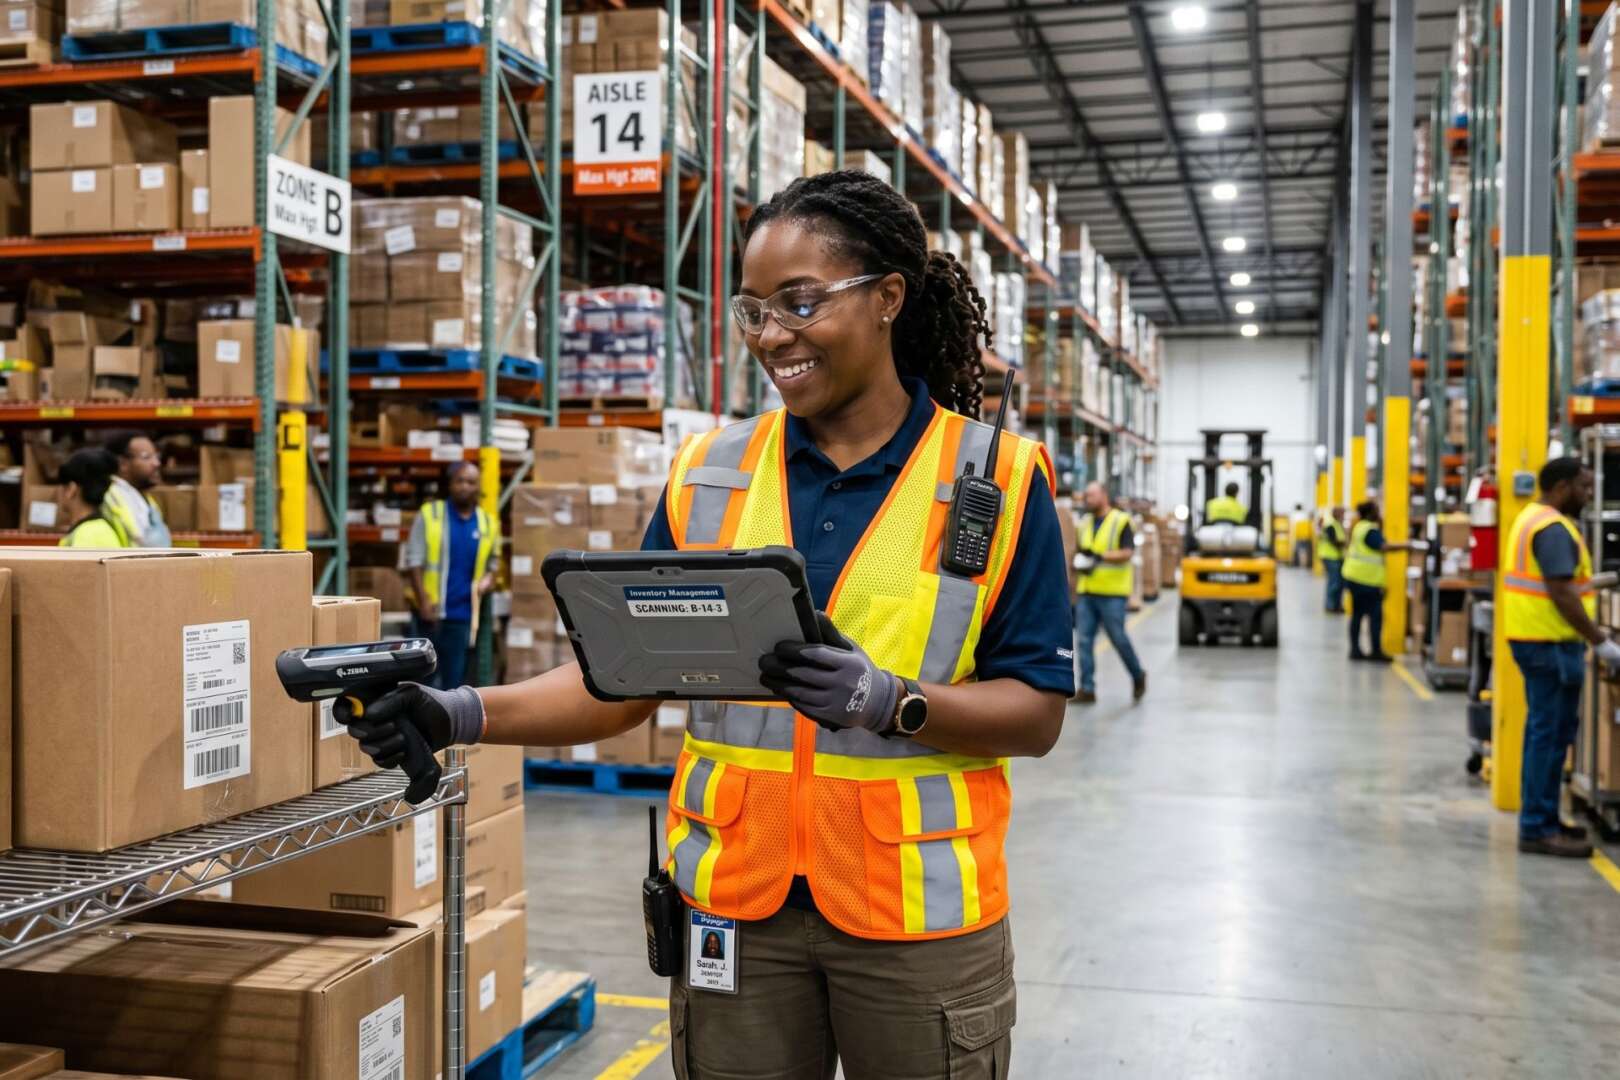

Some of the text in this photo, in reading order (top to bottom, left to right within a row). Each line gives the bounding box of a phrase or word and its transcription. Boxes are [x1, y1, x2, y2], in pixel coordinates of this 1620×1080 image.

[587, 81, 647, 103] AISLE
[590, 111, 645, 154] 14
[276, 169, 318, 206] ZONE
[325, 187, 343, 237] B
[629, 588, 720, 598] Inventory Management
[634, 603, 723, 614] SCANNING: B-14-3
[346, 666, 369, 676] ZEBRA
